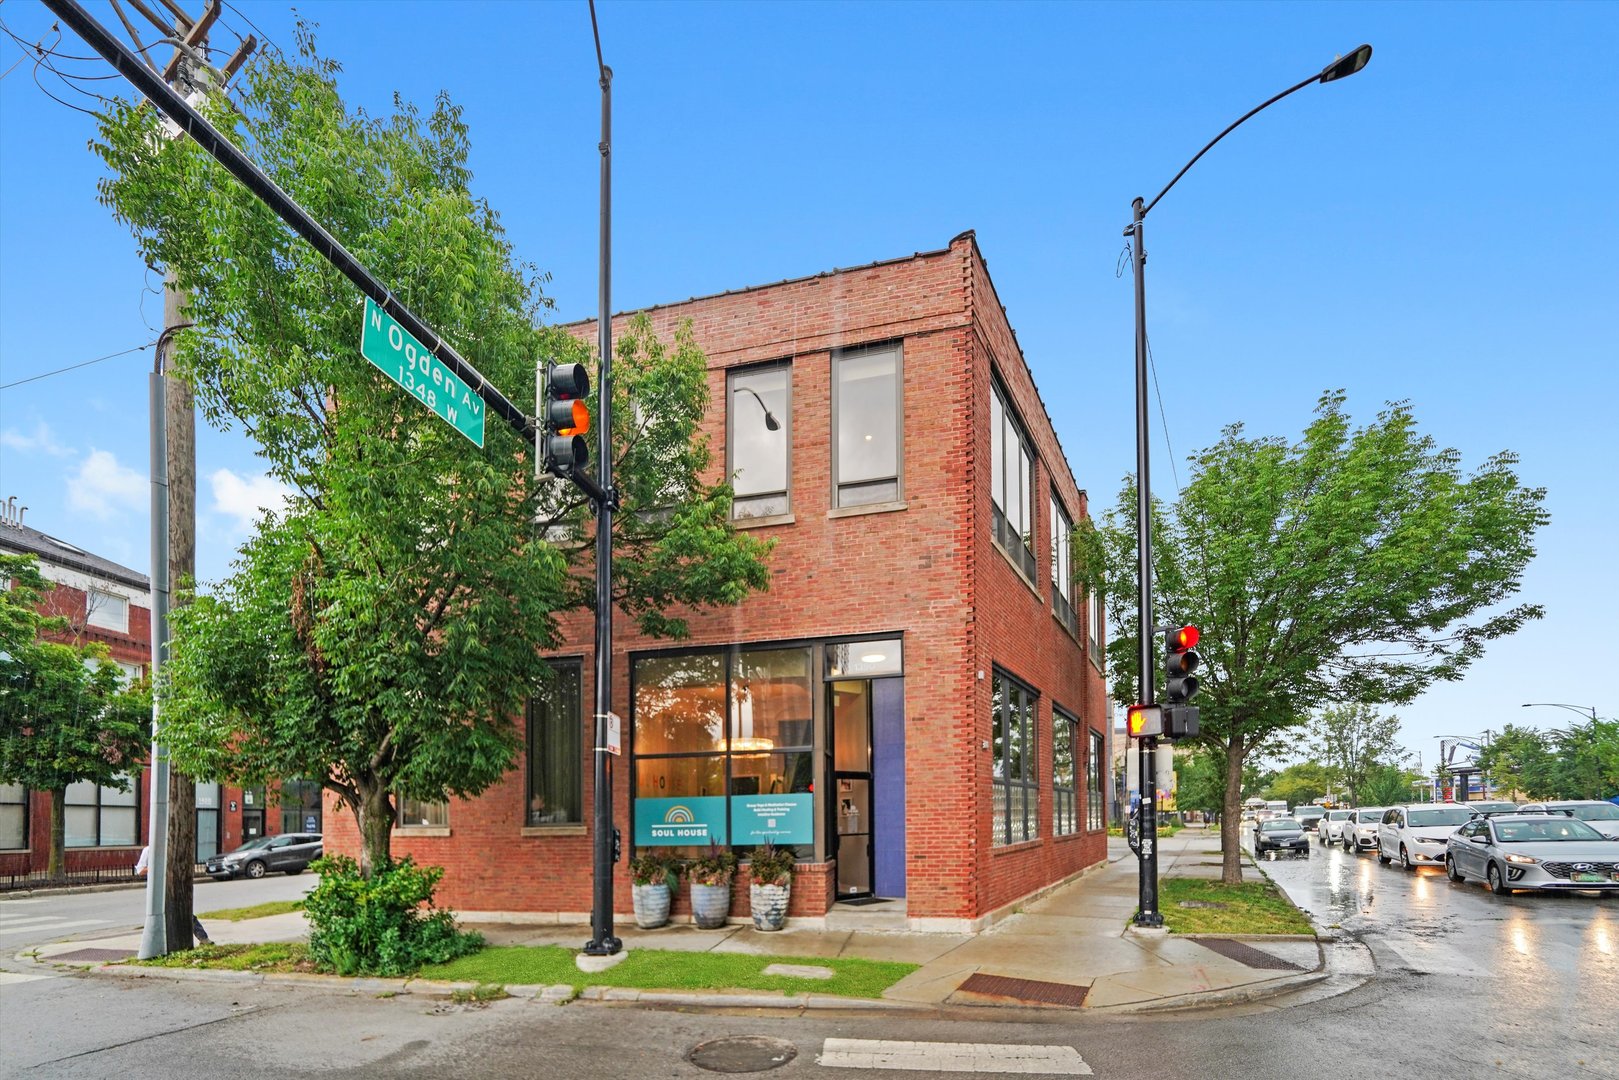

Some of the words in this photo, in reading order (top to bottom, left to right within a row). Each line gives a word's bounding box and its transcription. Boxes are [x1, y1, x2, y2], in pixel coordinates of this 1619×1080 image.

[371, 309, 382, 332] N
[388, 324, 455, 399] Ogden
[462, 391, 480, 415] Av
[398, 365, 437, 408] 1348
[446, 403, 458, 424] W
[651, 829, 675, 837] SOUL
[677, 829, 708, 837] HOUSE
